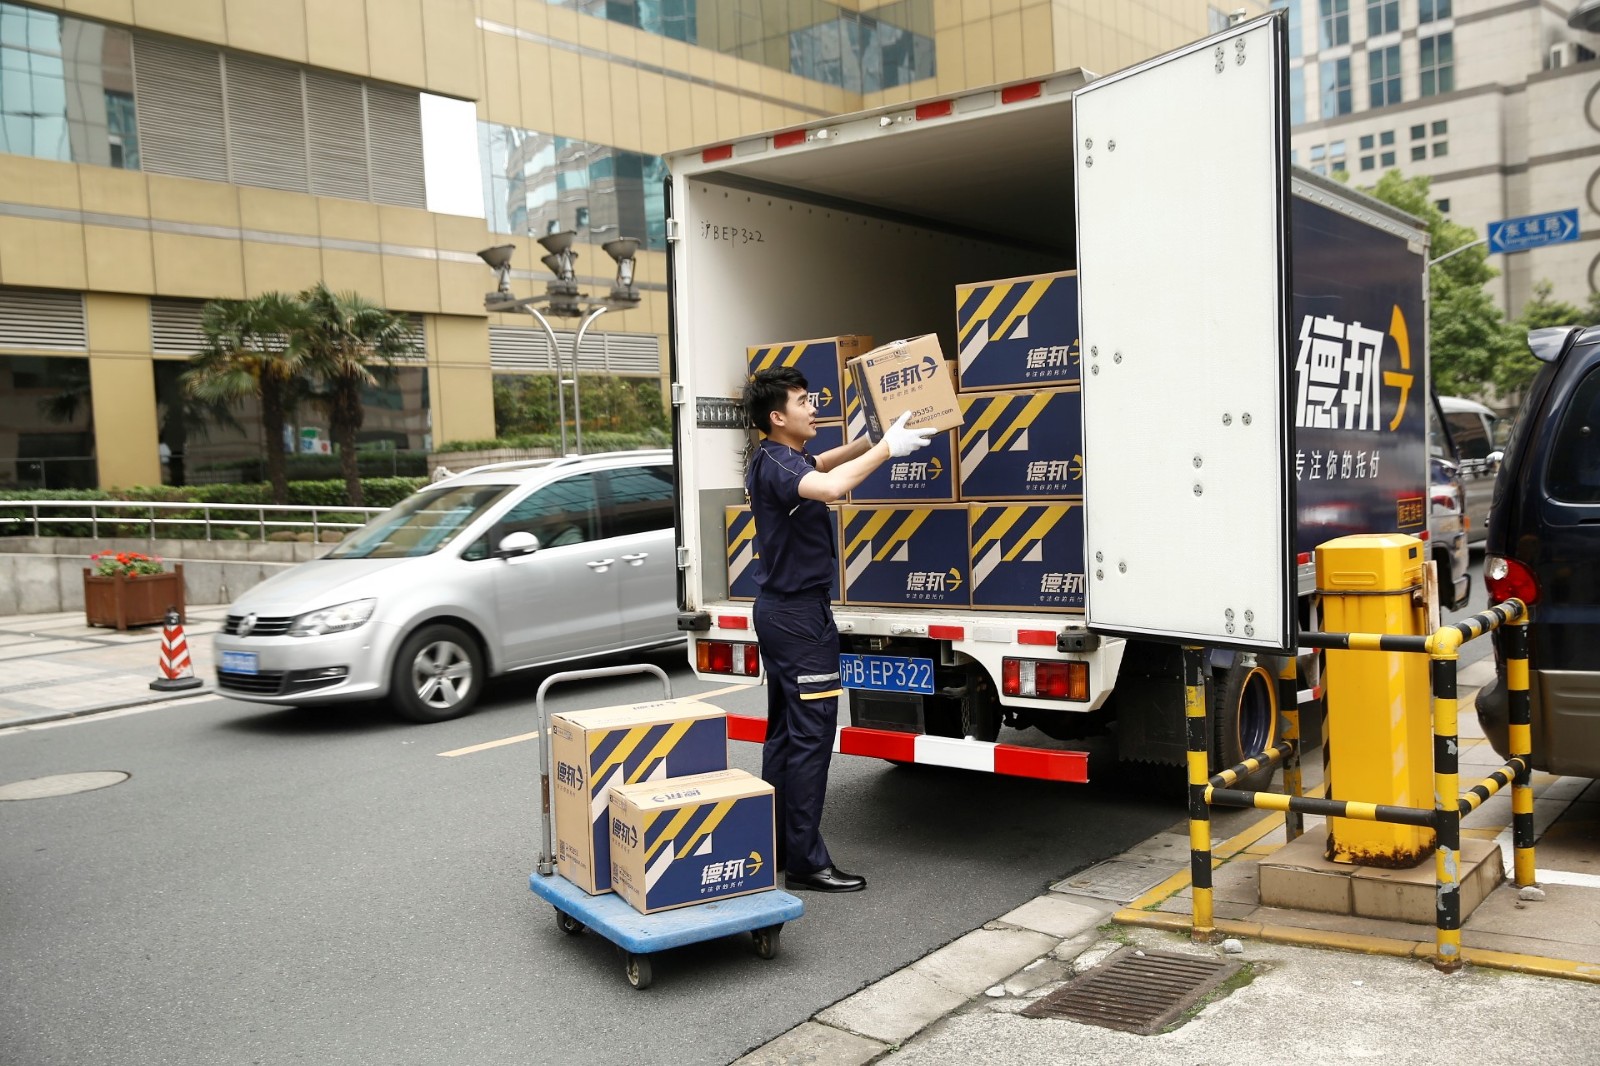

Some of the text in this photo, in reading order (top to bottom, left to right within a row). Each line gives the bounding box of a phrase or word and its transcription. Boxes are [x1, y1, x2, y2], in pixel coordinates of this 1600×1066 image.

[1026, 345, 1070, 369] 德邦
[880, 363, 922, 394] 德邦
[1295, 315, 1384, 431] 德邦
[912, 405, 934, 418] 95353
[890, 461, 929, 481] 德邦
[1026, 460, 1070, 481] 德邦
[1296, 450, 1380, 481] 专注你的托付
[906, 571, 947, 592] 德邦
[1040, 572, 1085, 594] 德邦
[701, 857, 746, 885] 德邦
